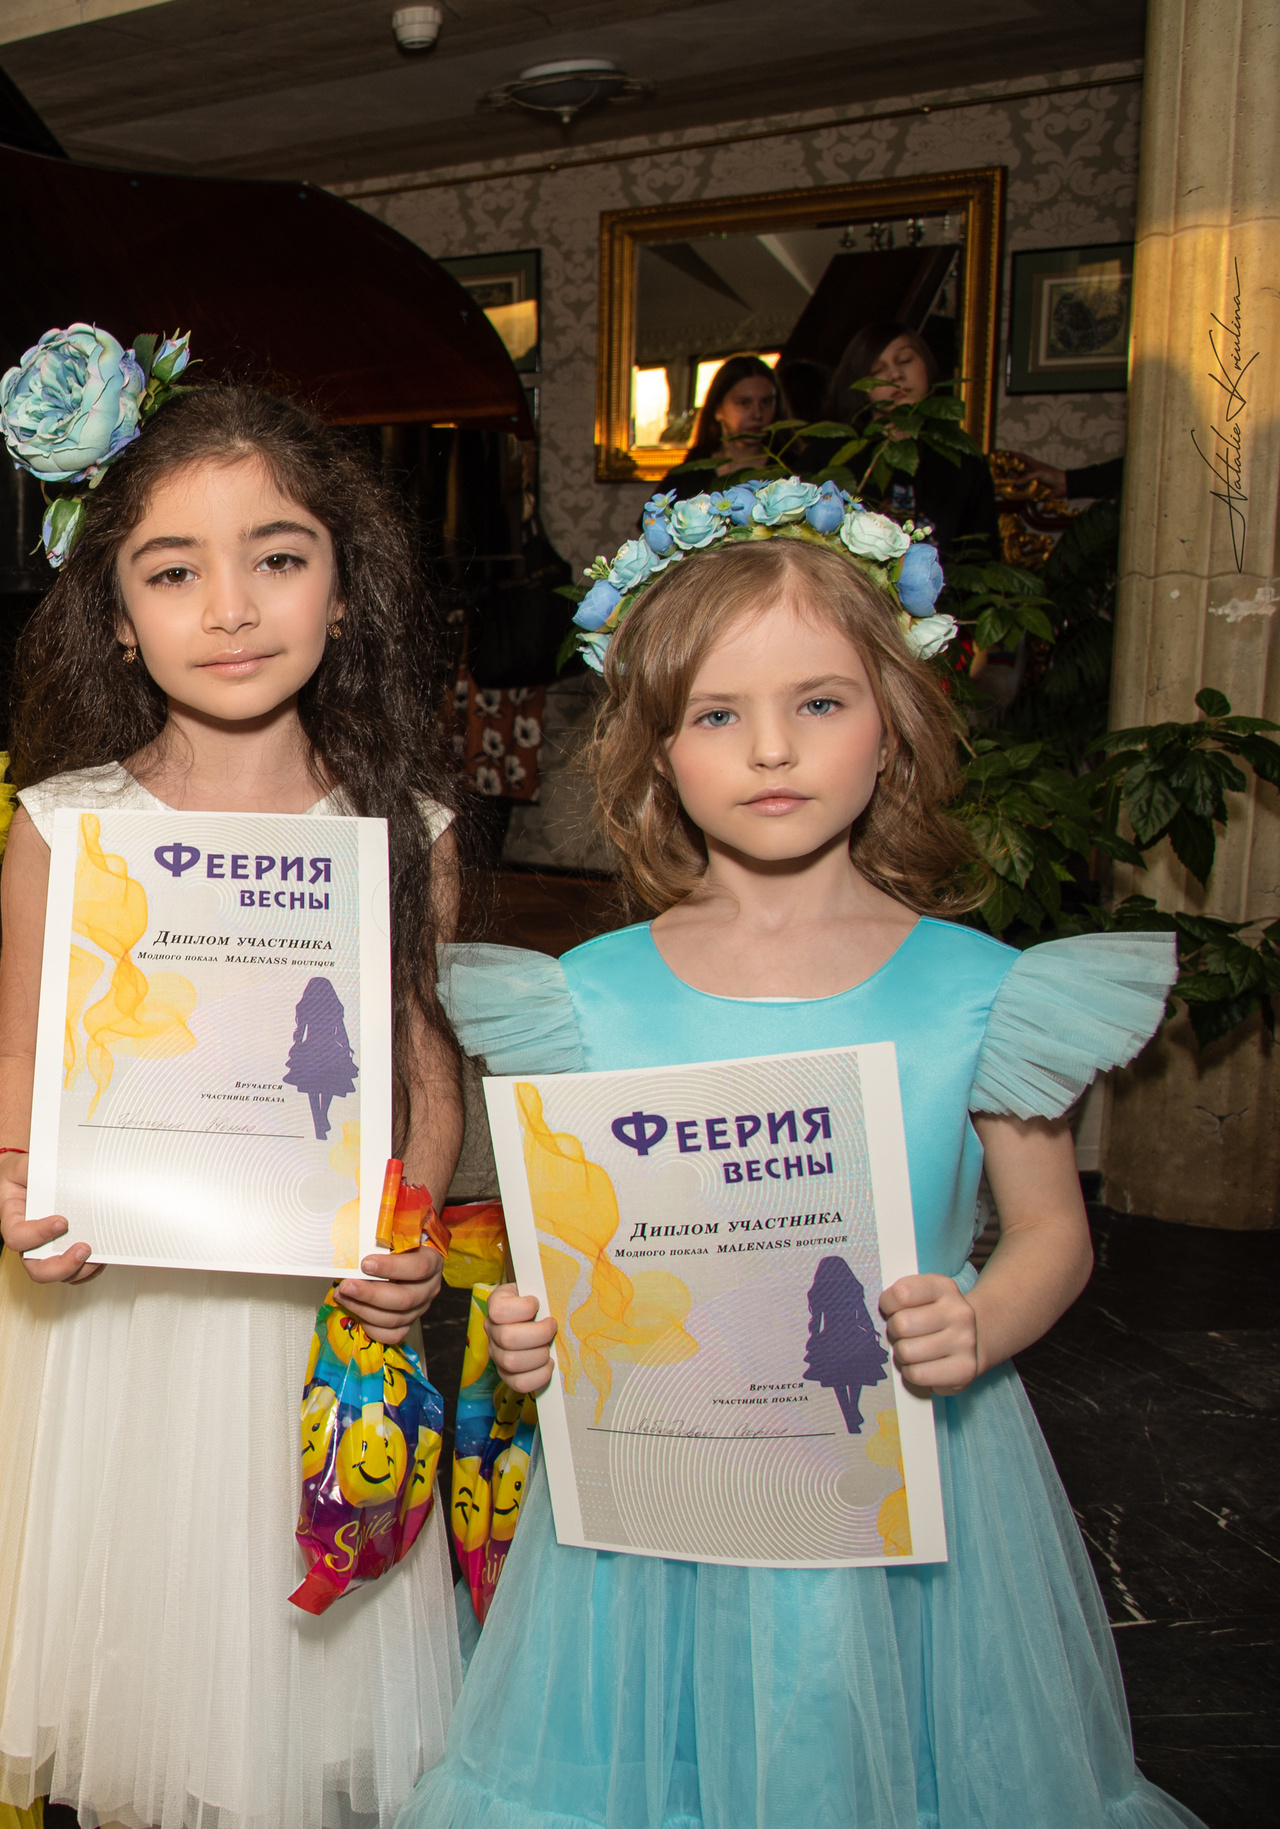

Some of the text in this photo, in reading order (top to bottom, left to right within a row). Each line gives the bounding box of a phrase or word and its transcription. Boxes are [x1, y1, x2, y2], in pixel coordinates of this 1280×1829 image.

[154, 842, 332, 885] ФЕЕРИЯ
[240, 890, 330, 910] ВЕСНЫ
[225, 955, 288, 965] MALENASS
[611, 1107, 832, 1156] ФЕЕРИЯ
[723, 1152, 834, 1184] ВЕСНЫ
[717, 1239, 791, 1253] MALENASS
[325, 1512, 397, 1573] Smile
